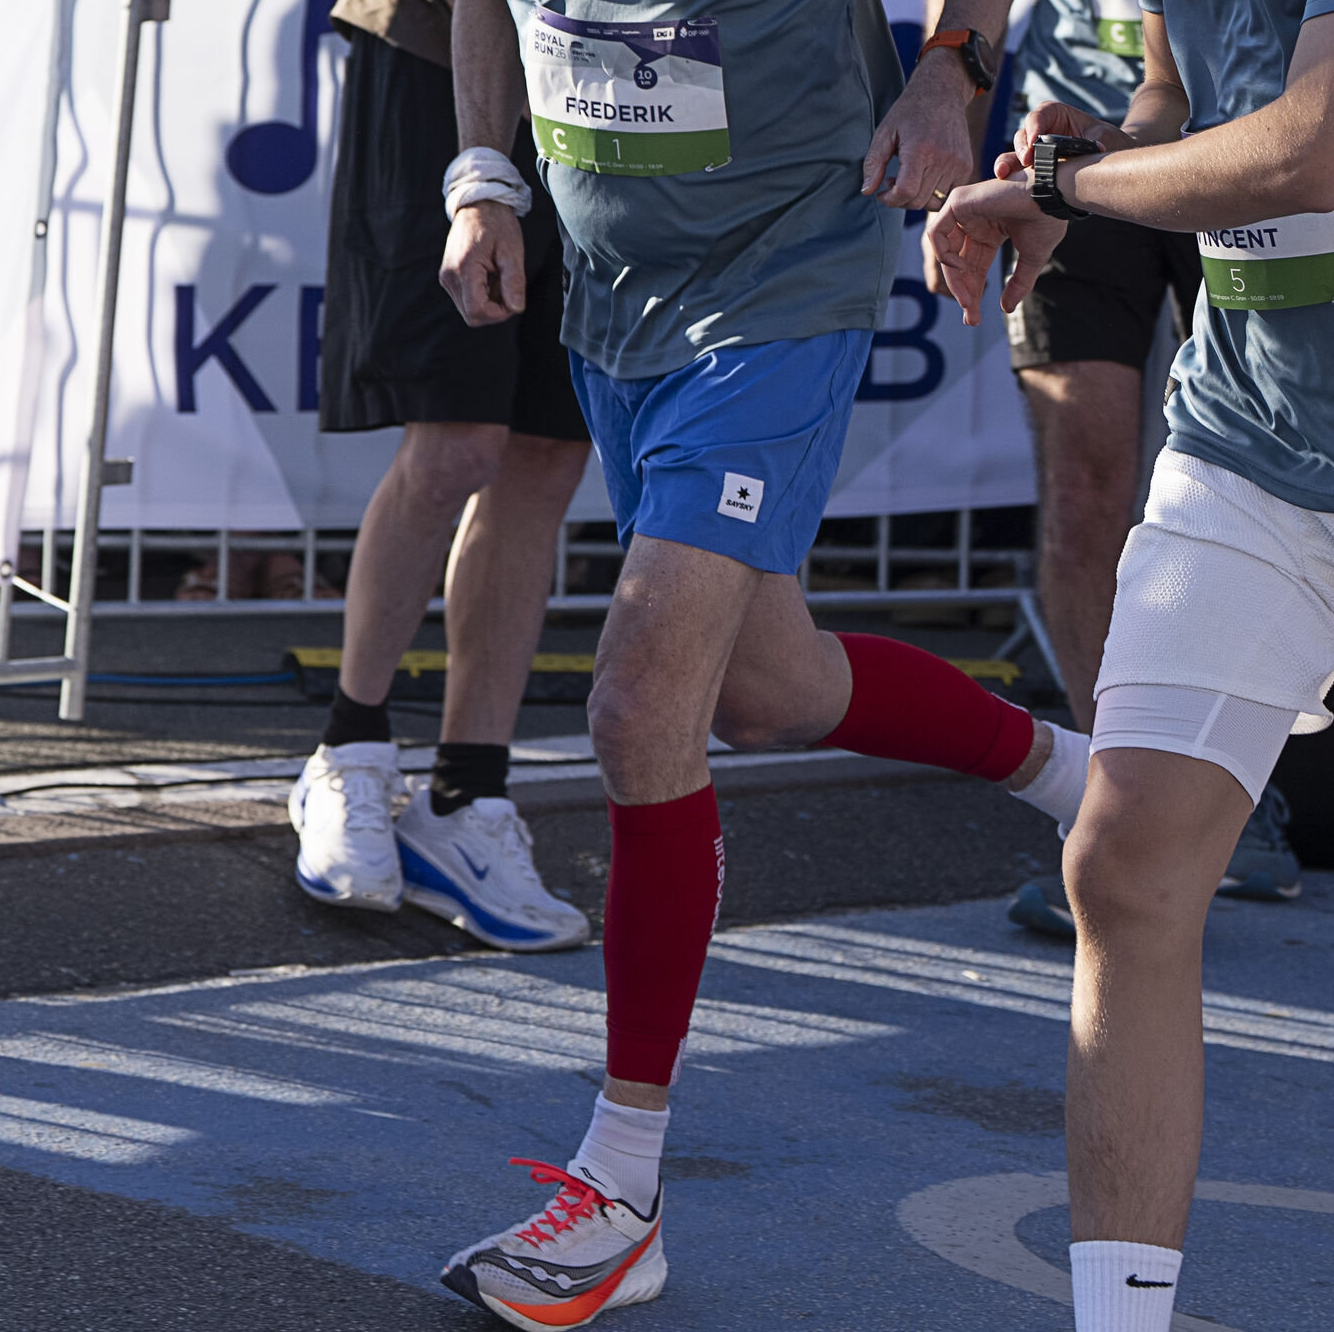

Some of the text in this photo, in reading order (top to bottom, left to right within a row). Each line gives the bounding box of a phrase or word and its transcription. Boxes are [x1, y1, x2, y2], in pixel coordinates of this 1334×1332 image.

[535, 30, 565, 48] ROYAL
[637, 70, 652, 80] 10
[566, 96, 674, 123] FREDERIK
[552, 127, 622, 161] C 1
[1230, 268, 1245, 293] 5
